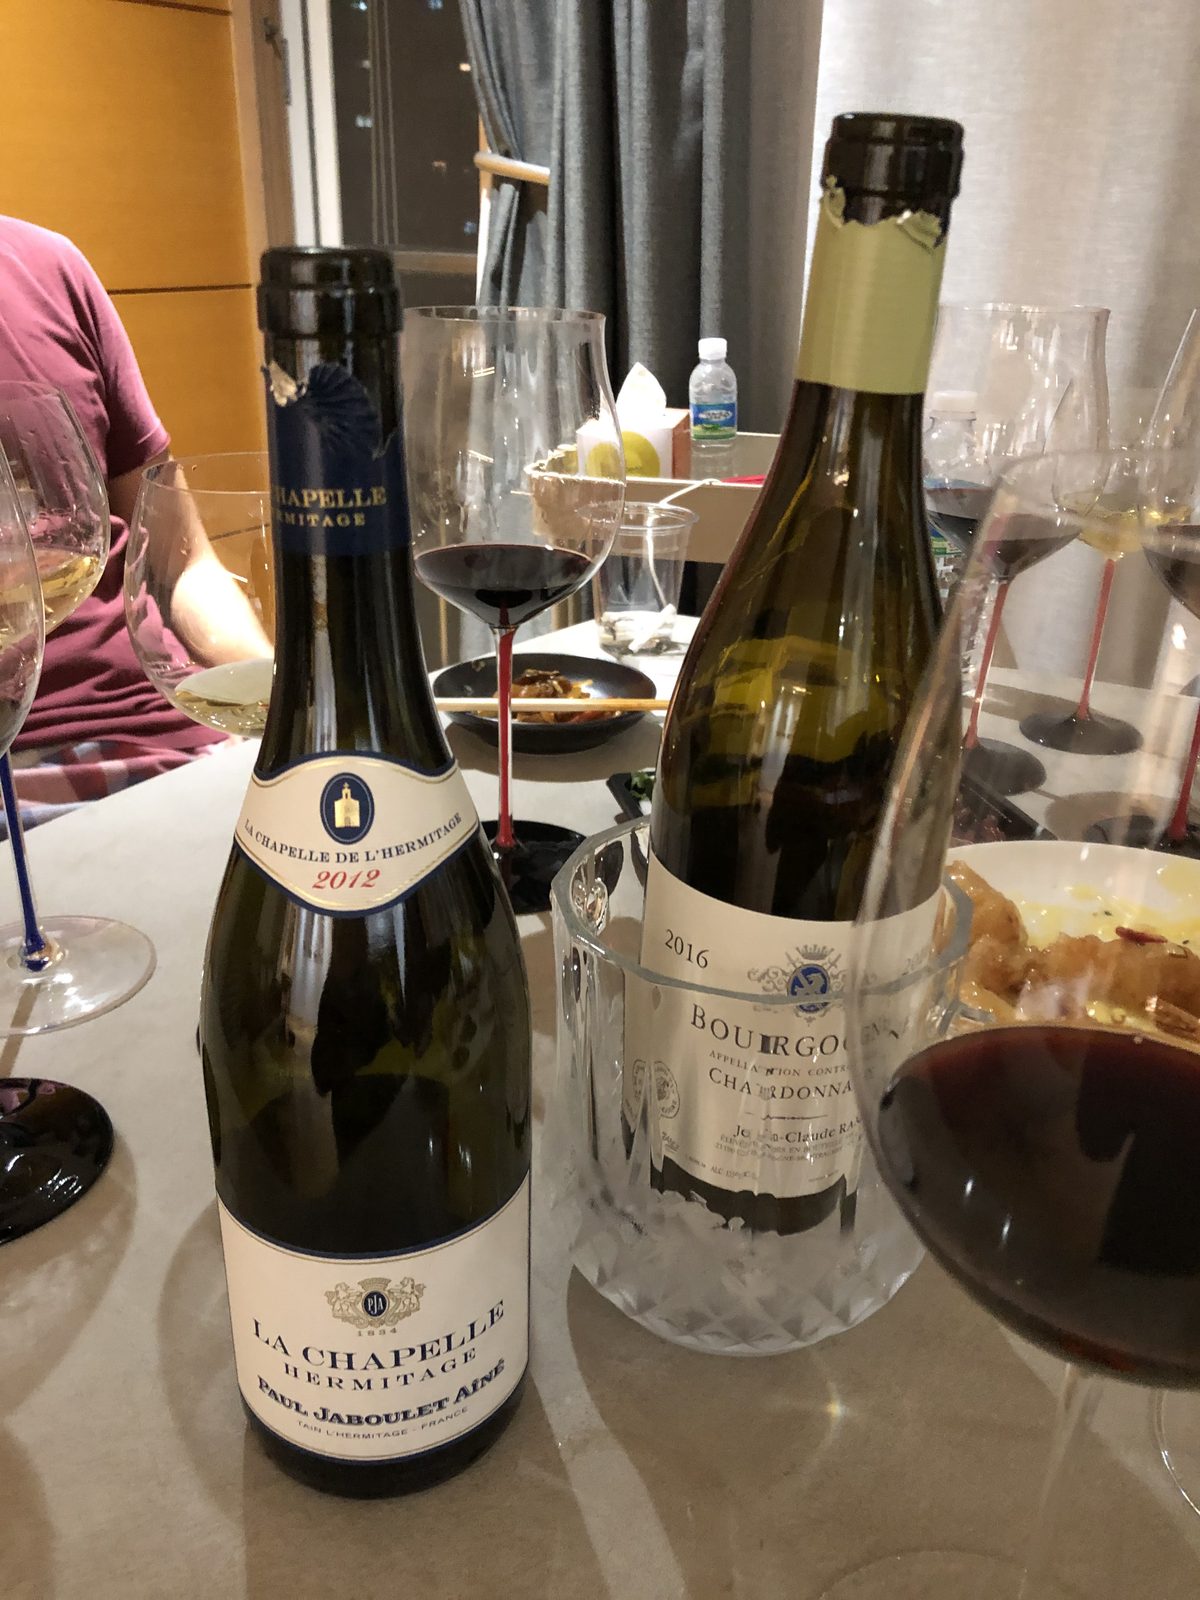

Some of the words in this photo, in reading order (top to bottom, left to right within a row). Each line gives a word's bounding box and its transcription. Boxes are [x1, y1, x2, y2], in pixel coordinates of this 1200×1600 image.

[244, 818, 254, 837] LA
[255, 831, 330, 863] CHAPELLE
[336, 852, 360, 864] DE
[364, 812, 463, 862] L'HERMITAGE
[312, 869, 381, 890] 2012
[664, 929, 710, 969] 2016
[367, 1294, 384, 1315] PJA
[252, 1317, 290, 1357] LA
[302, 1300, 505, 1371] CHAPELLE
[358, 1327, 397, 1337] 1834
[283, 1347, 477, 1391] HERMITAGE
[257, 1375, 308, 1416] PAUL
[313, 1397, 450, 1427] JABOULET
[298, 1421, 322, 1434] TAIN
[326, 1428, 409, 1440] L'HERMITAGE
[421, 1406, 468, 1430] FRANCE
